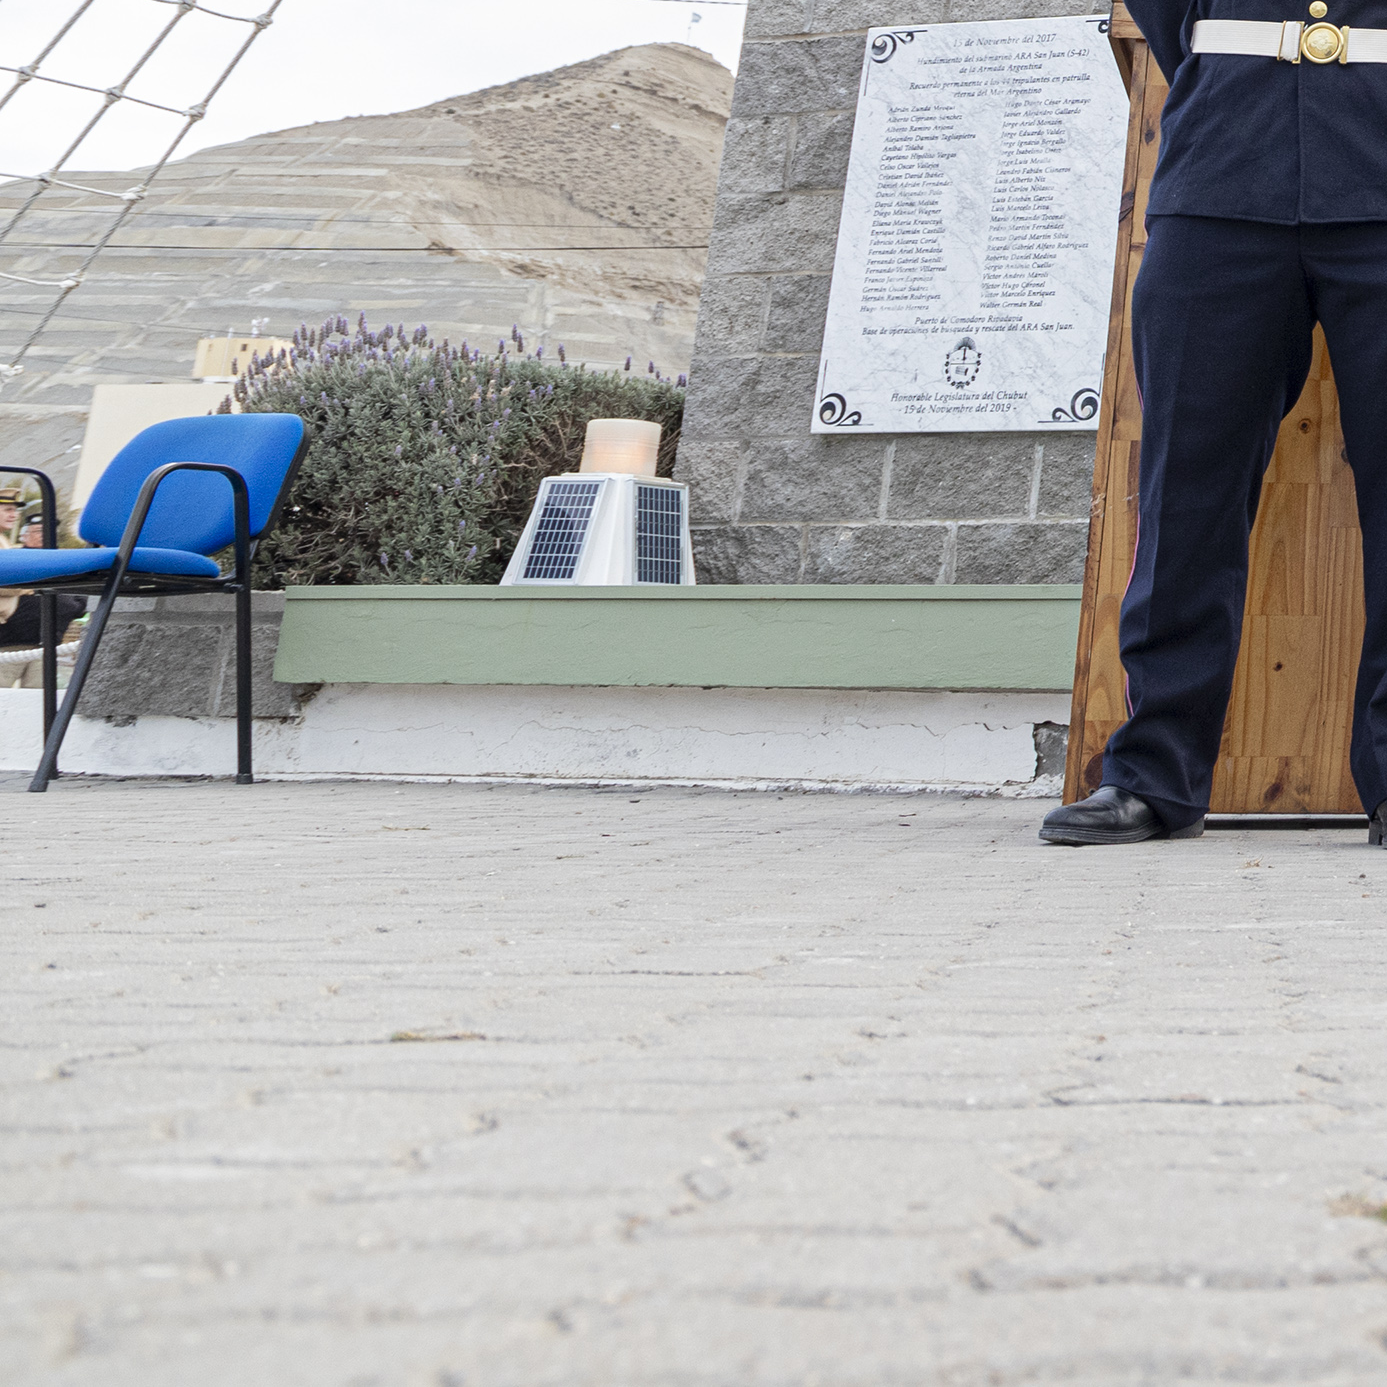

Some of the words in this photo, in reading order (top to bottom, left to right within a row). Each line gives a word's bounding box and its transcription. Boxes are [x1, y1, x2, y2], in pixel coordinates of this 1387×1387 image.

[965, 38, 974, 46] de
[976, 37, 1020, 46] Noviembre
[1036, 34, 1056, 43] 2017
[918, 56, 962, 65] Hundimiento
[976, 54, 1012, 62] submarino
[1049, 51, 1065, 60] Juan
[1067, 49, 1090, 58] (S-42)
[1007, 63, 1042, 73] Argentina
[909, 82, 941, 90] Recuerdo
[942, 80, 982, 90] permanente
[1012, 76, 1050, 85] tripulantes
[1062, 73, 1090, 83] patrulla
[1007, 87, 1042, 97] Argentino
[950, 316, 985, 324] Comodoro
[987, 315, 1023, 323] Rivadavia
[862, 327, 877, 335] Base
[889, 326, 929, 336] operaciones
[1007, 323, 1018, 332] del
[1020, 323, 1038, 331] ARA
[1040, 323, 1054, 331] San
[1056, 322, 1075, 332] Juan.
[891, 393, 932, 402] Honorable
[934, 392, 980, 403] Legislatura
[982, 391, 994, 400] del
[996, 390, 1028, 400] Chubut
[917, 405, 927, 413] de
[929, 404, 976, 414] Noviembre
[978, 404, 988, 413] del
[990, 404, 1011, 413] 2019
